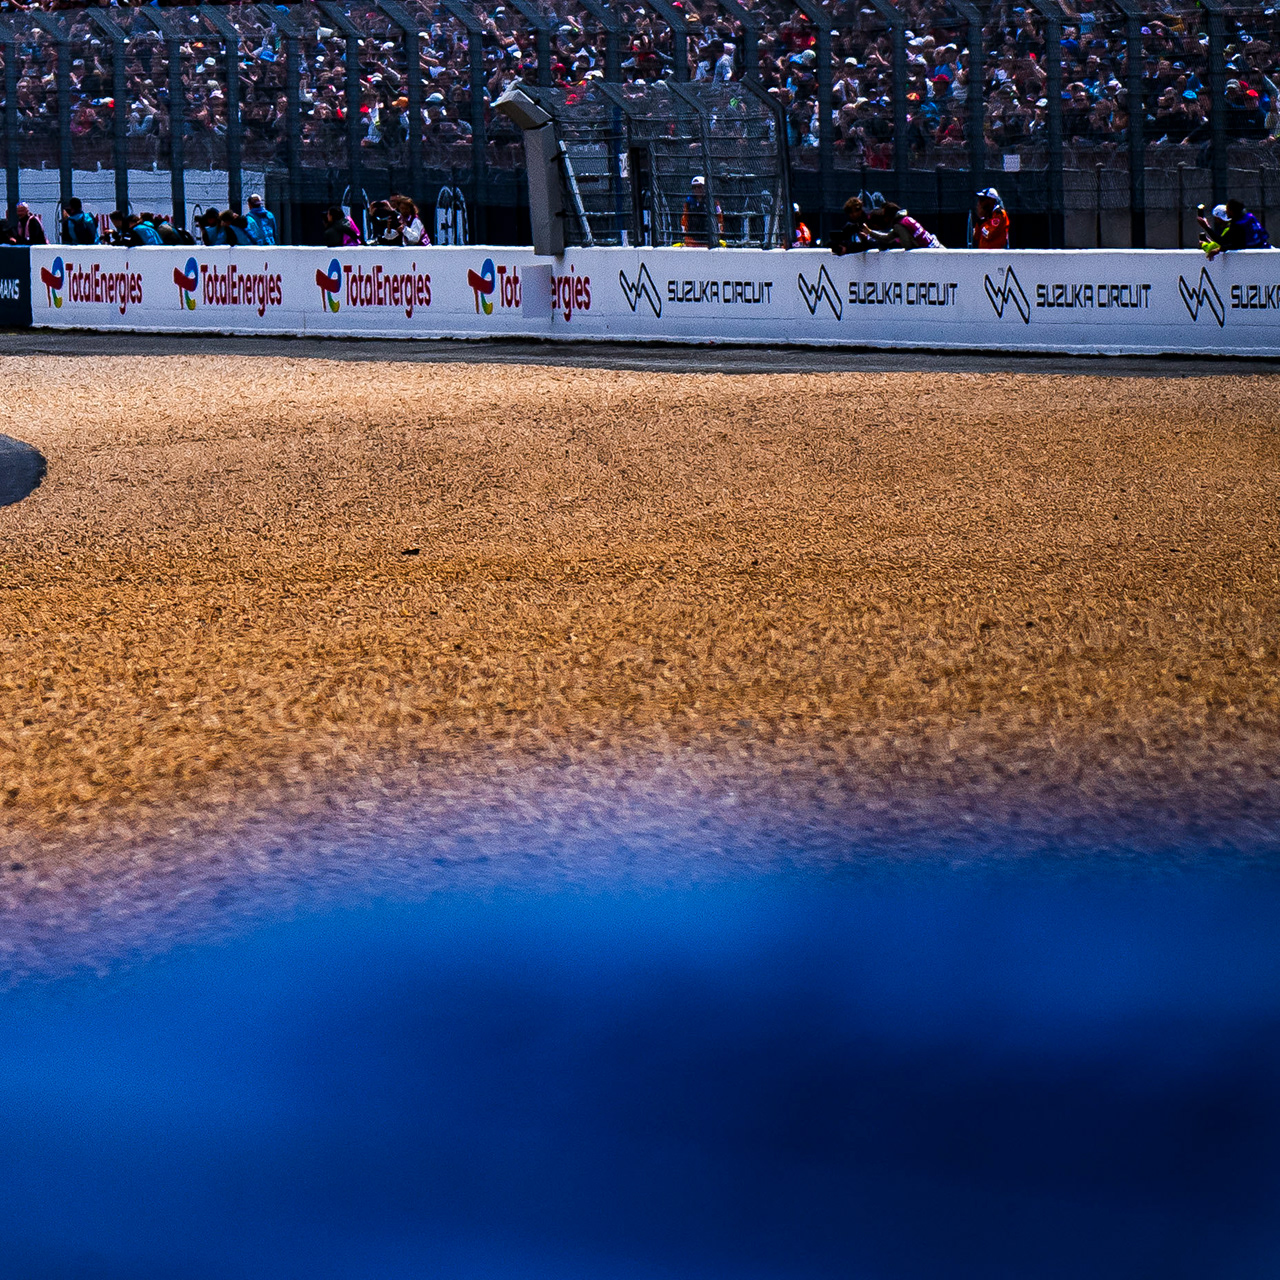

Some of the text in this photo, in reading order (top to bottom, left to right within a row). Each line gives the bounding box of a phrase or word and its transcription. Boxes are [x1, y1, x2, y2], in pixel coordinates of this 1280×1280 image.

[65, 262, 143, 315] TotalEnergies
[200, 263, 282, 317] TotalEnergies
[343, 262, 431, 319] TotalEnergies
[496, 263, 591, 322] Totergies
[667, 280, 773, 304] SUZUKA CIRCUIT
[848, 281, 958, 306] SUZUKA CIRCUIT
[1036, 283, 1152, 309] SUZUKA CIRCUIT
[1230, 284, 1280, 310] SUZUK
